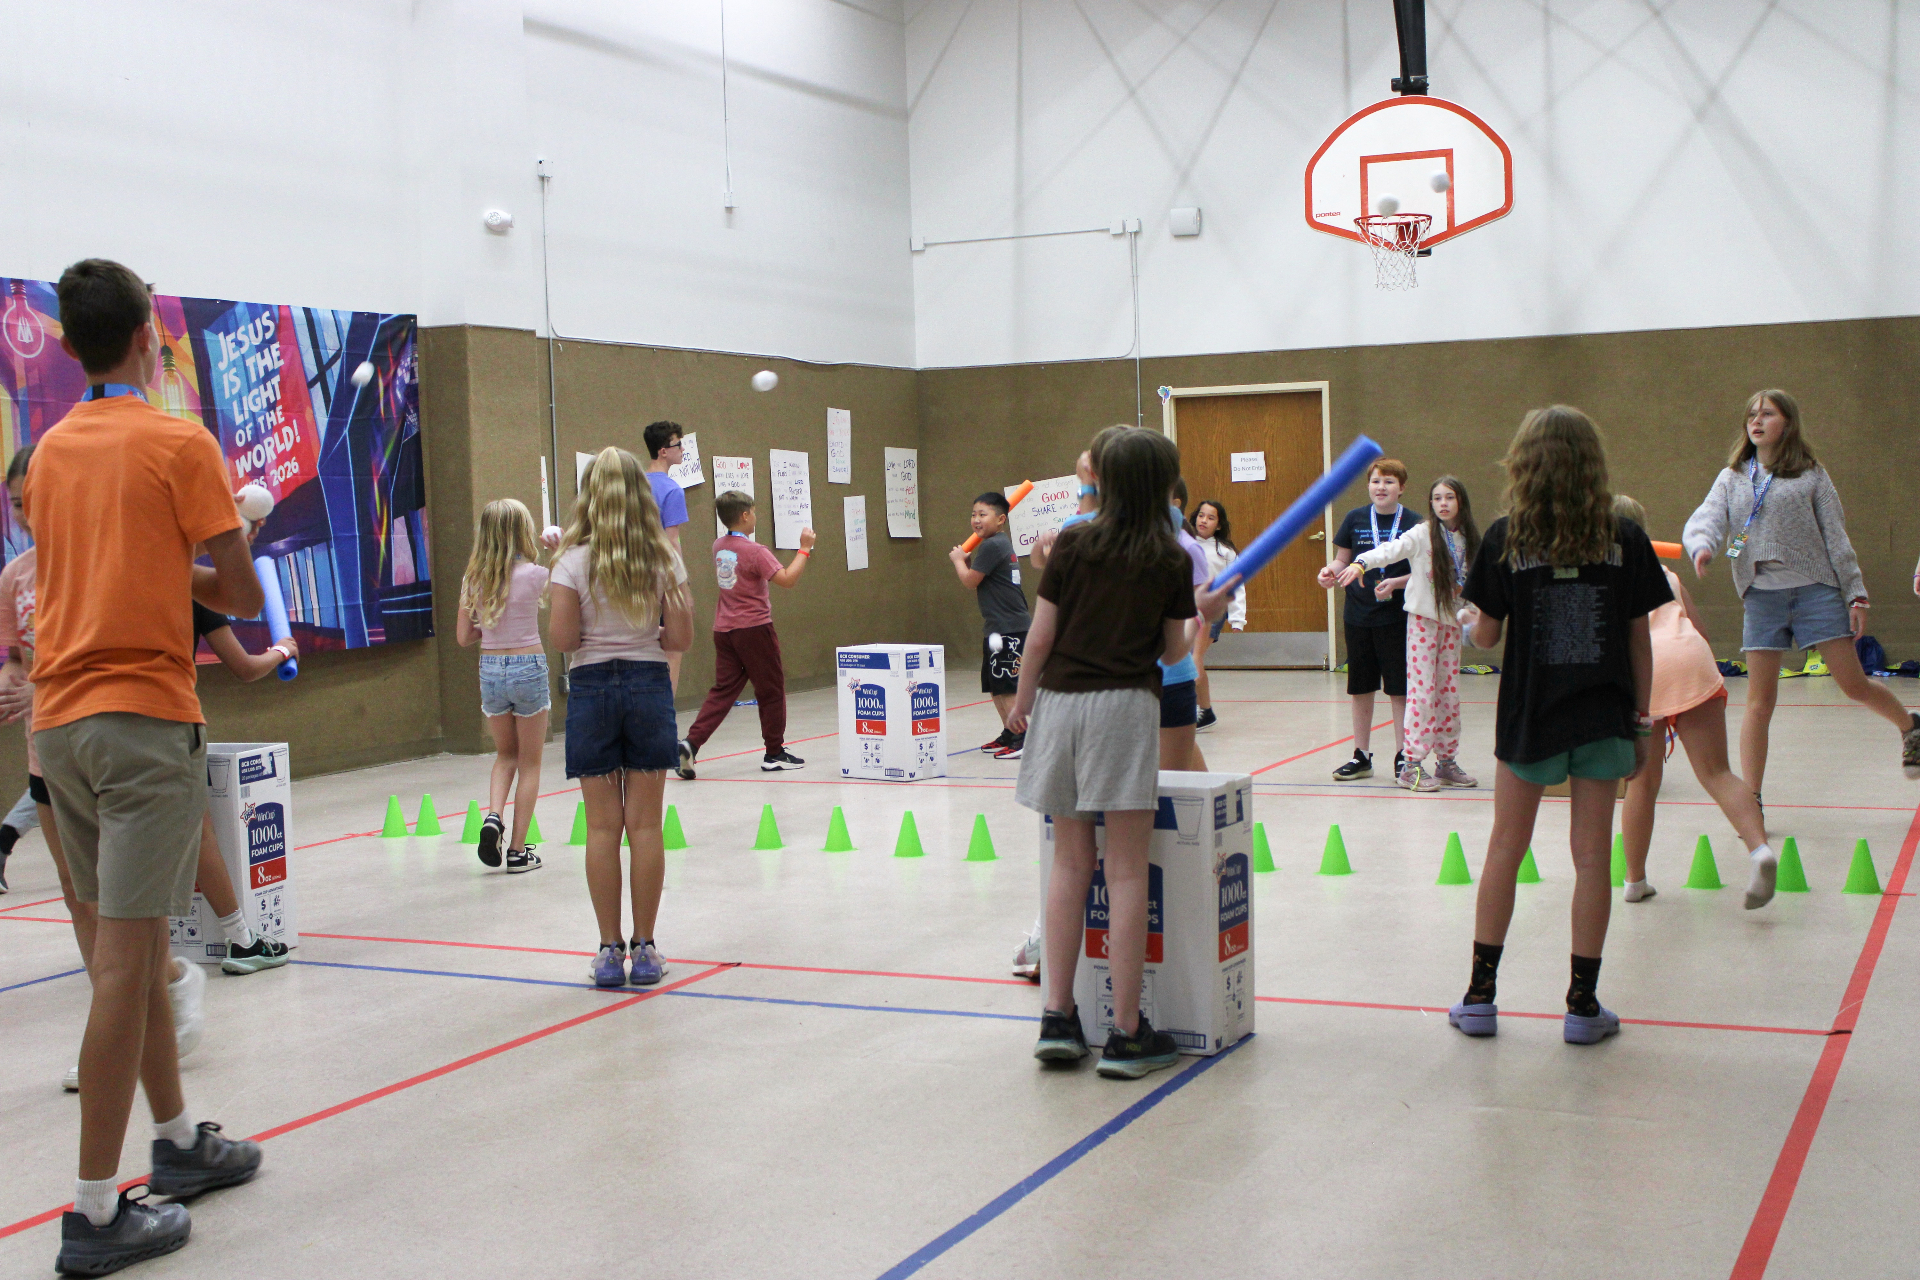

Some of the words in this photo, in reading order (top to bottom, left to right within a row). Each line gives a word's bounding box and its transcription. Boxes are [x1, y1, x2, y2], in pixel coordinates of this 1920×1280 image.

[218, 311, 275, 370] JESUS
[223, 367, 241, 399] IS
[246, 341, 285, 383] THE
[232, 374, 281, 426] LIGHT
[236, 422, 253, 447] OF
[257, 405, 285, 434] THE
[235, 419, 301, 478] WORLD!
[270, 457, 299, 487] 2026
[1031, 504, 1057, 517] SHARE
[1041, 490, 1069, 503] GOOD
[1019, 530, 1039, 546] God
[256, 810, 276, 822] WinCup
[251, 846, 268, 858] FOAM
[268, 842, 284, 853] CUPS
